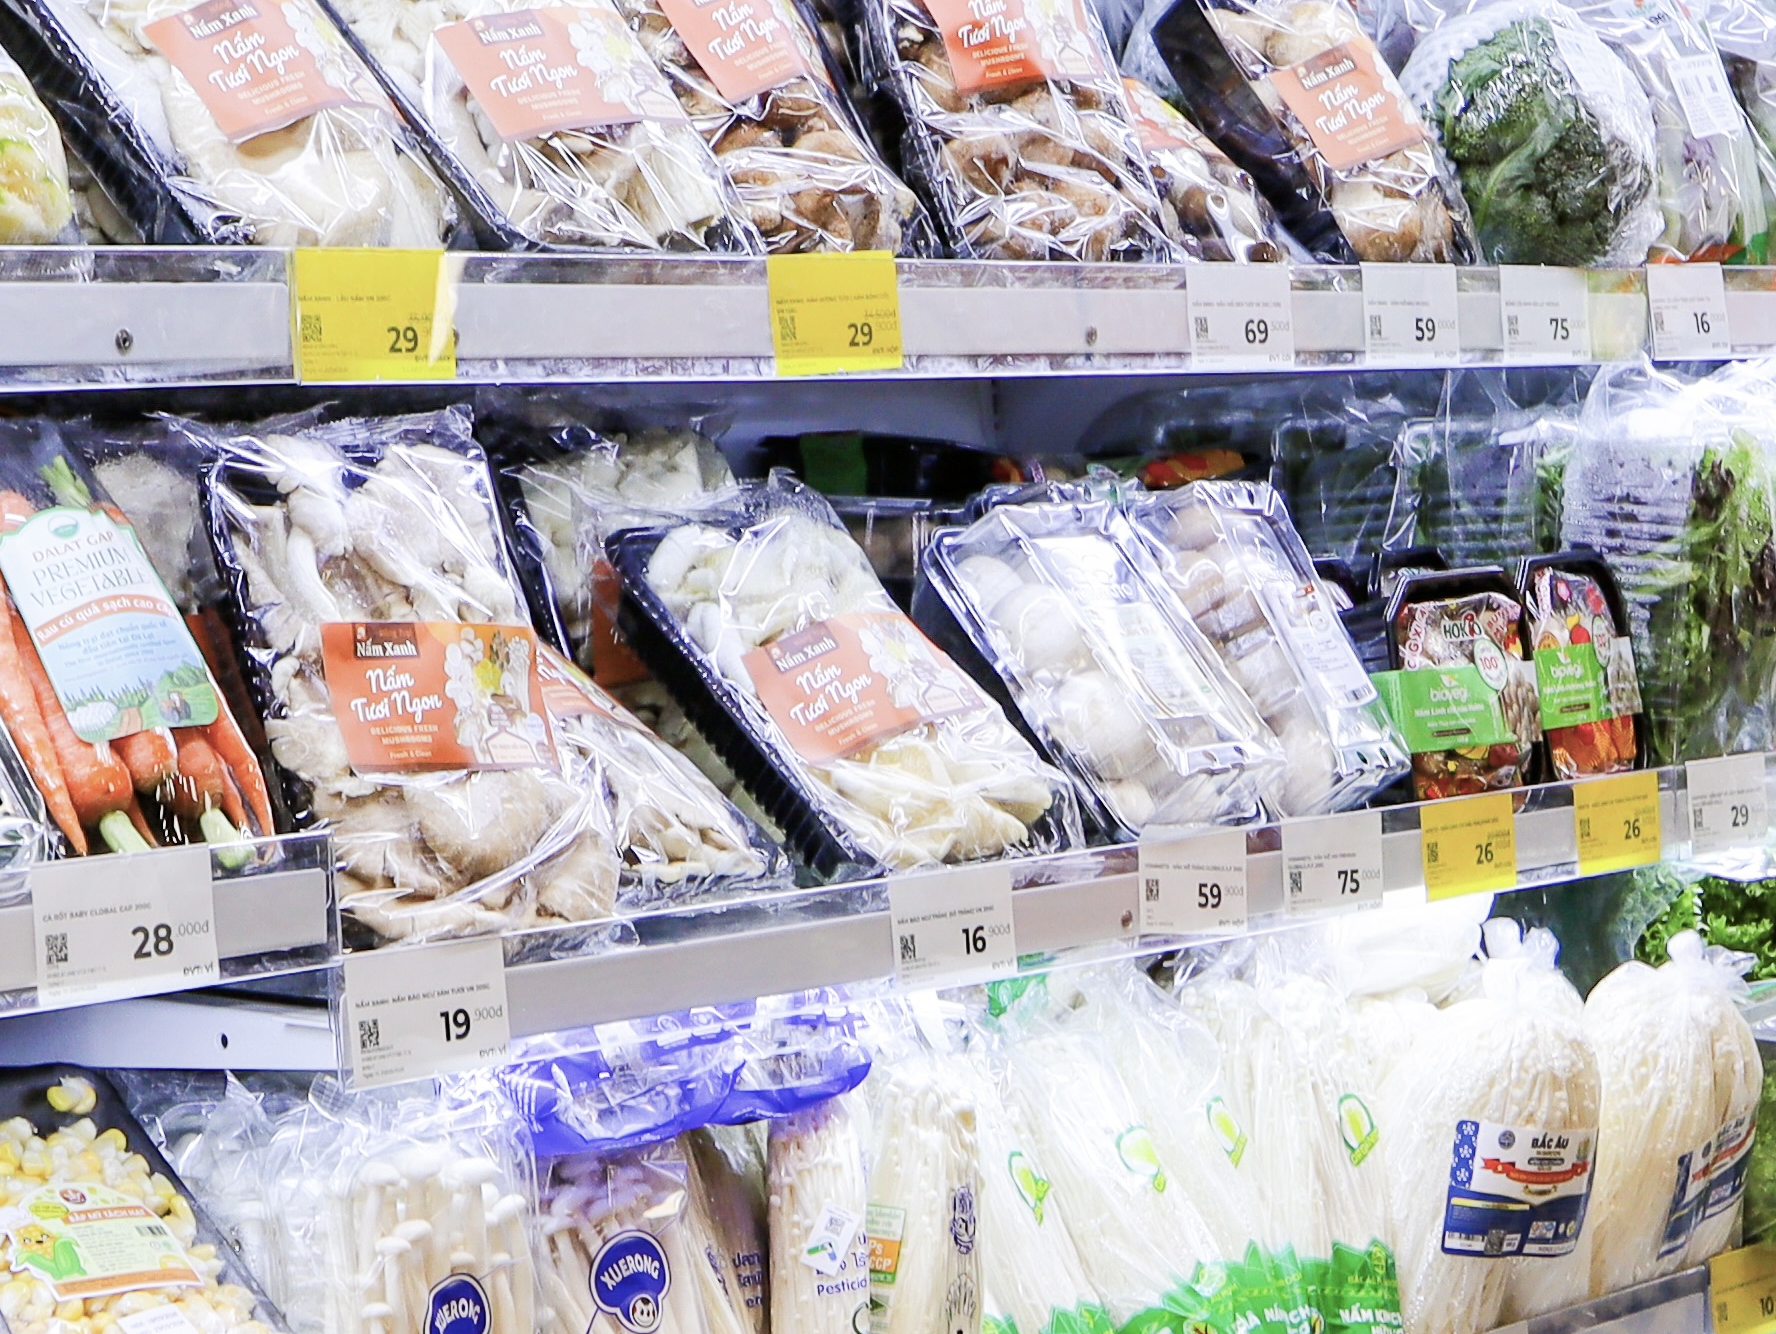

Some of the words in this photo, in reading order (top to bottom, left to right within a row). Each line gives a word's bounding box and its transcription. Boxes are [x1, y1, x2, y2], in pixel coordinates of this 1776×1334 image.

[32, 538, 84, 564] DALAT
[86, 530, 115, 547] GAP
[31, 545, 135, 587] PREMIUM
[29, 566, 152, 610] VEGETABLE
[355, 638, 385, 658] Nấm
[383, 639, 418, 657] Xanh
[365, 664, 415, 694] Nấm
[795, 662, 842, 696] Nấm
[827, 673, 872, 705] Ngon
[390, 690, 443, 724] Ngon
[600, 1252, 662, 1293] XUERONG
